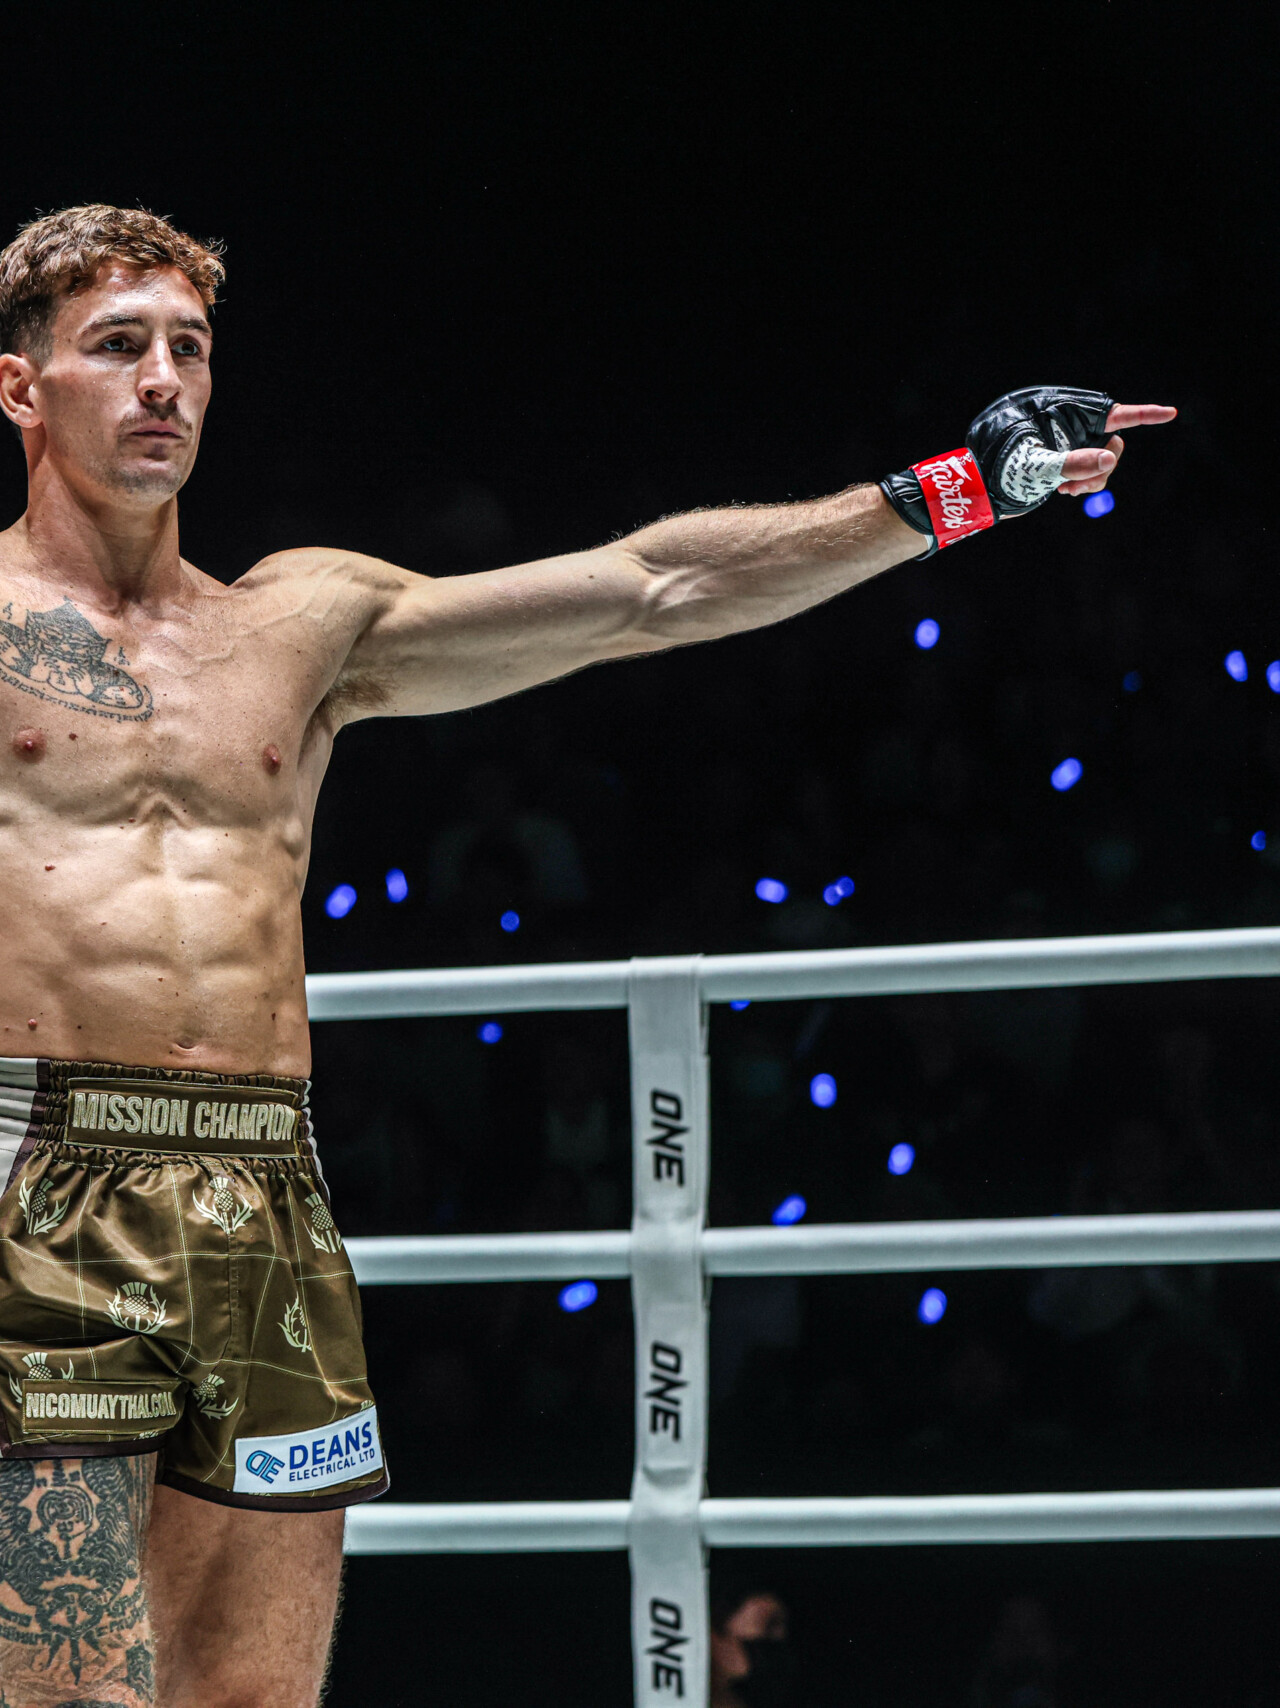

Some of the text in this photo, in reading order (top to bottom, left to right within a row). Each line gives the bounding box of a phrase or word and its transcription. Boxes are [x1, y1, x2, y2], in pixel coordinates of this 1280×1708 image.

[918, 456, 973, 529] Fairtex
[72, 1092, 296, 1141] MISSION CHAMPION
[645, 1087, 691, 1188] ONE
[643, 1341, 690, 1442] ONE
[289, 1421, 373, 1470] DEANS
[289, 1447, 376, 1482] ELECTRICAL LTD
[644, 1597, 691, 1698] ONE
